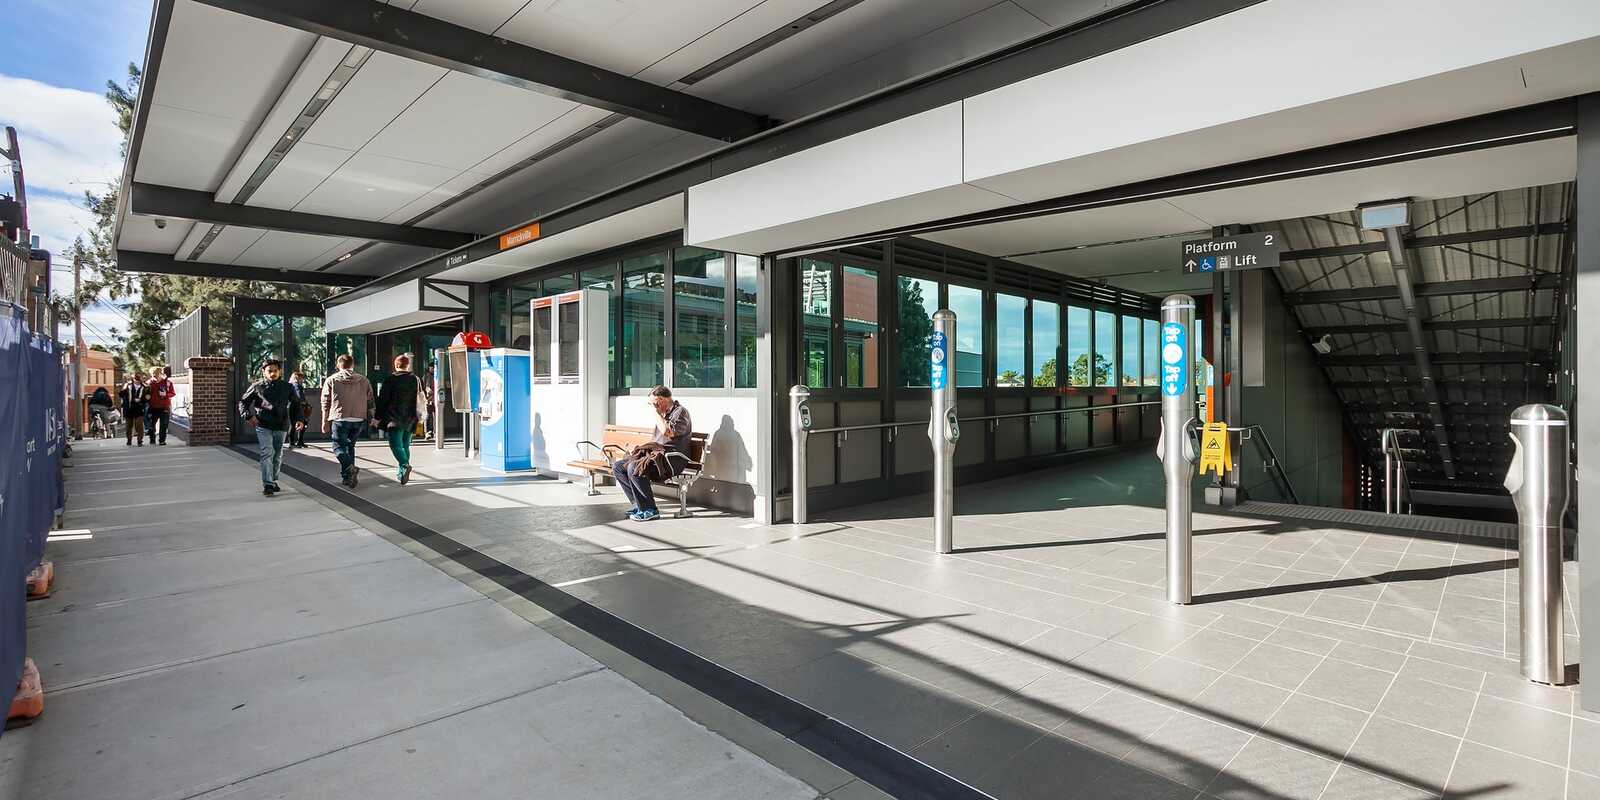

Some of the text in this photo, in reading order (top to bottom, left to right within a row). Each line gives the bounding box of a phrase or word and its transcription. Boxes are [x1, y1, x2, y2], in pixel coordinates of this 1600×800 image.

[1185, 234, 1274, 255] Platform 2
[1235, 254, 1257, 267] Lift
